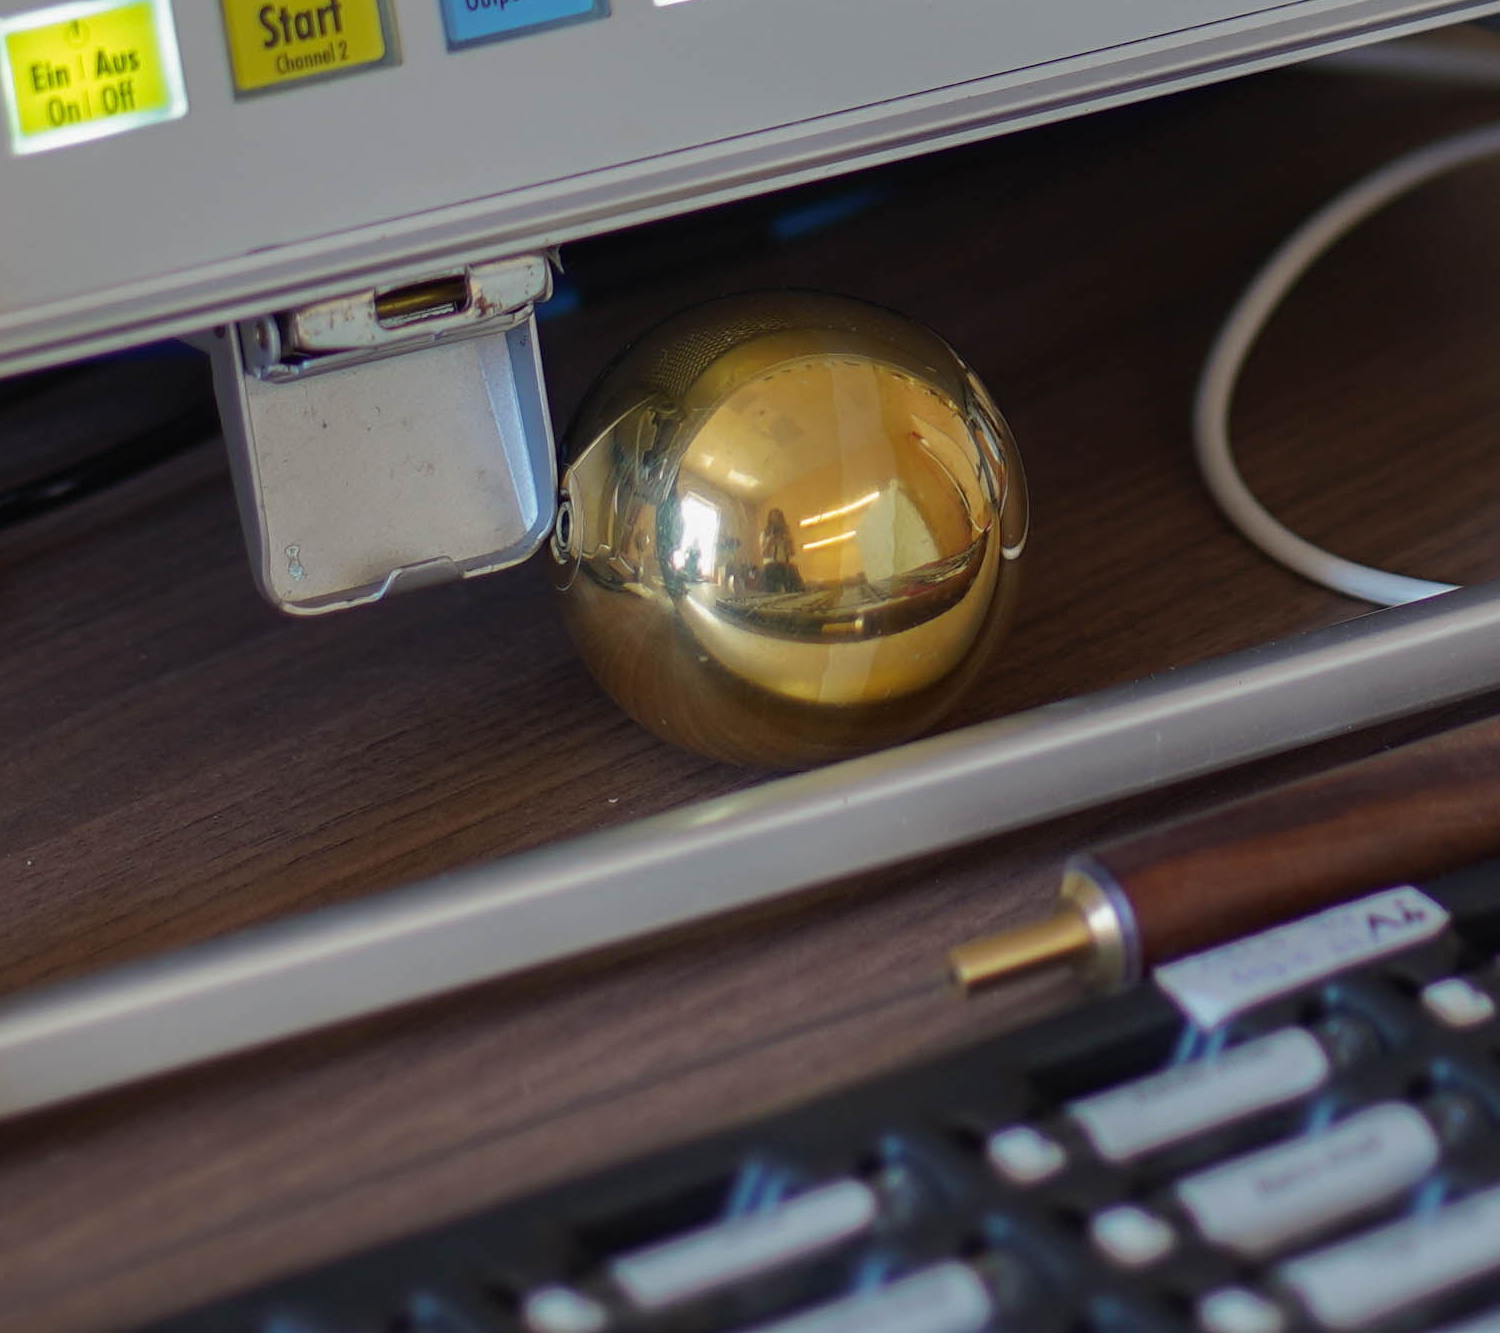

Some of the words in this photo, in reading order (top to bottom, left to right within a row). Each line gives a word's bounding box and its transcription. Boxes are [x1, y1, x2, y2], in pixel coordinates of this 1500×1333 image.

[31, 64, 70, 94] Ein
[94, 47, 141, 79] Aus
[275, 43, 333, 75] Channel
[337, 40, 349, 61] 2
[46, 96, 82, 127] On
[102, 81, 136, 113] Off
